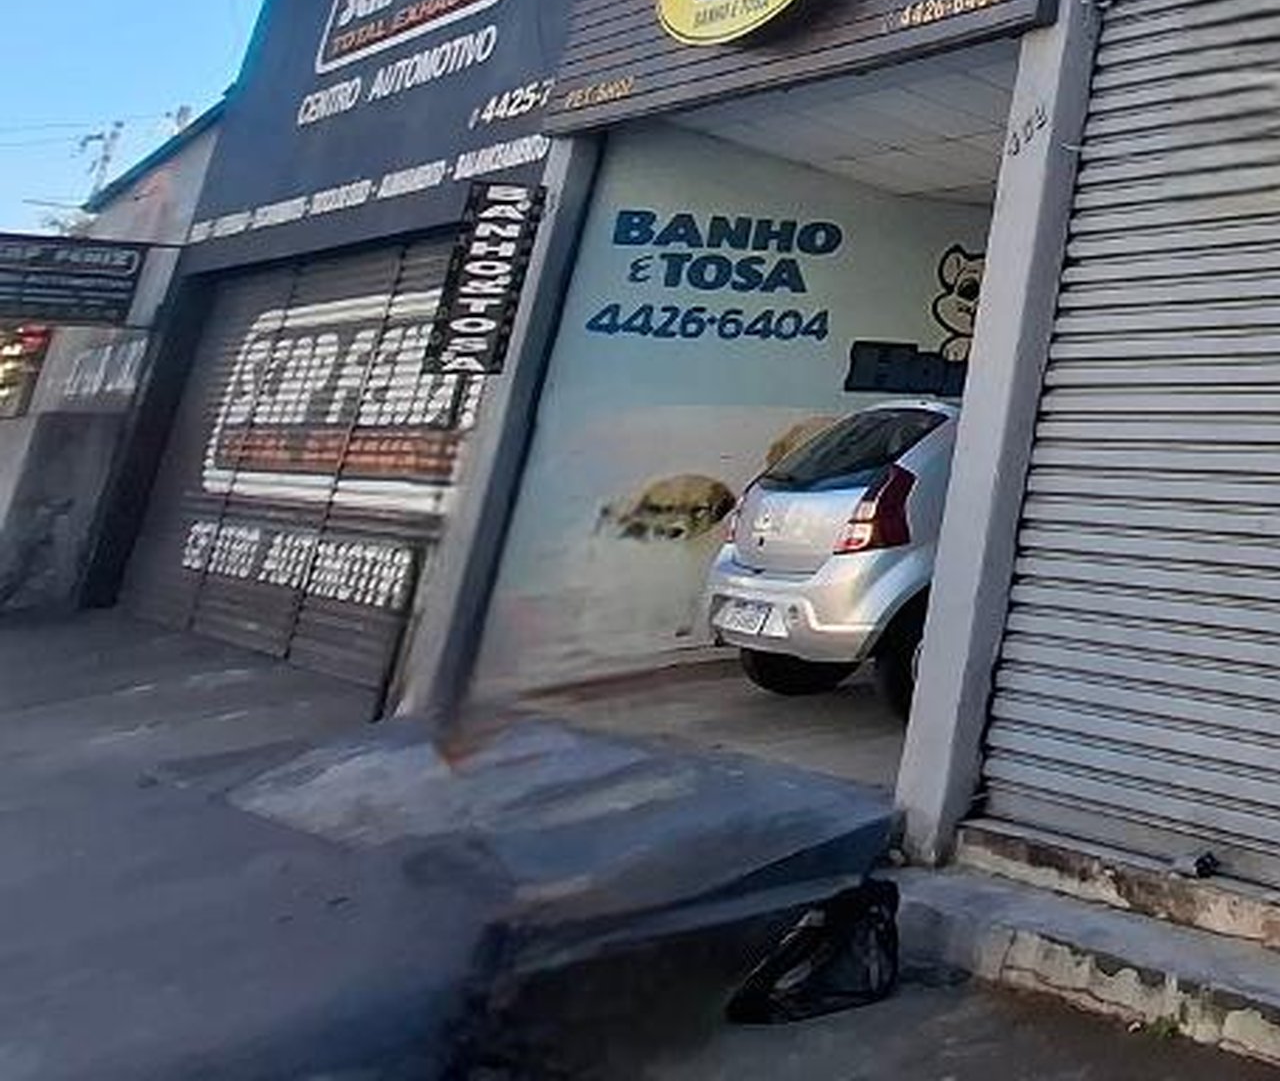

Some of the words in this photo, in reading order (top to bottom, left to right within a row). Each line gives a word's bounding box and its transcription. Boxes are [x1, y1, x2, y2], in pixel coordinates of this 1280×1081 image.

[298, 77, 362, 125] CENTRO
[366, 25, 497, 102] AUTOMOTIVO
[613, 210, 843, 255] BANHO
[659, 252, 807, 293] TOSA
